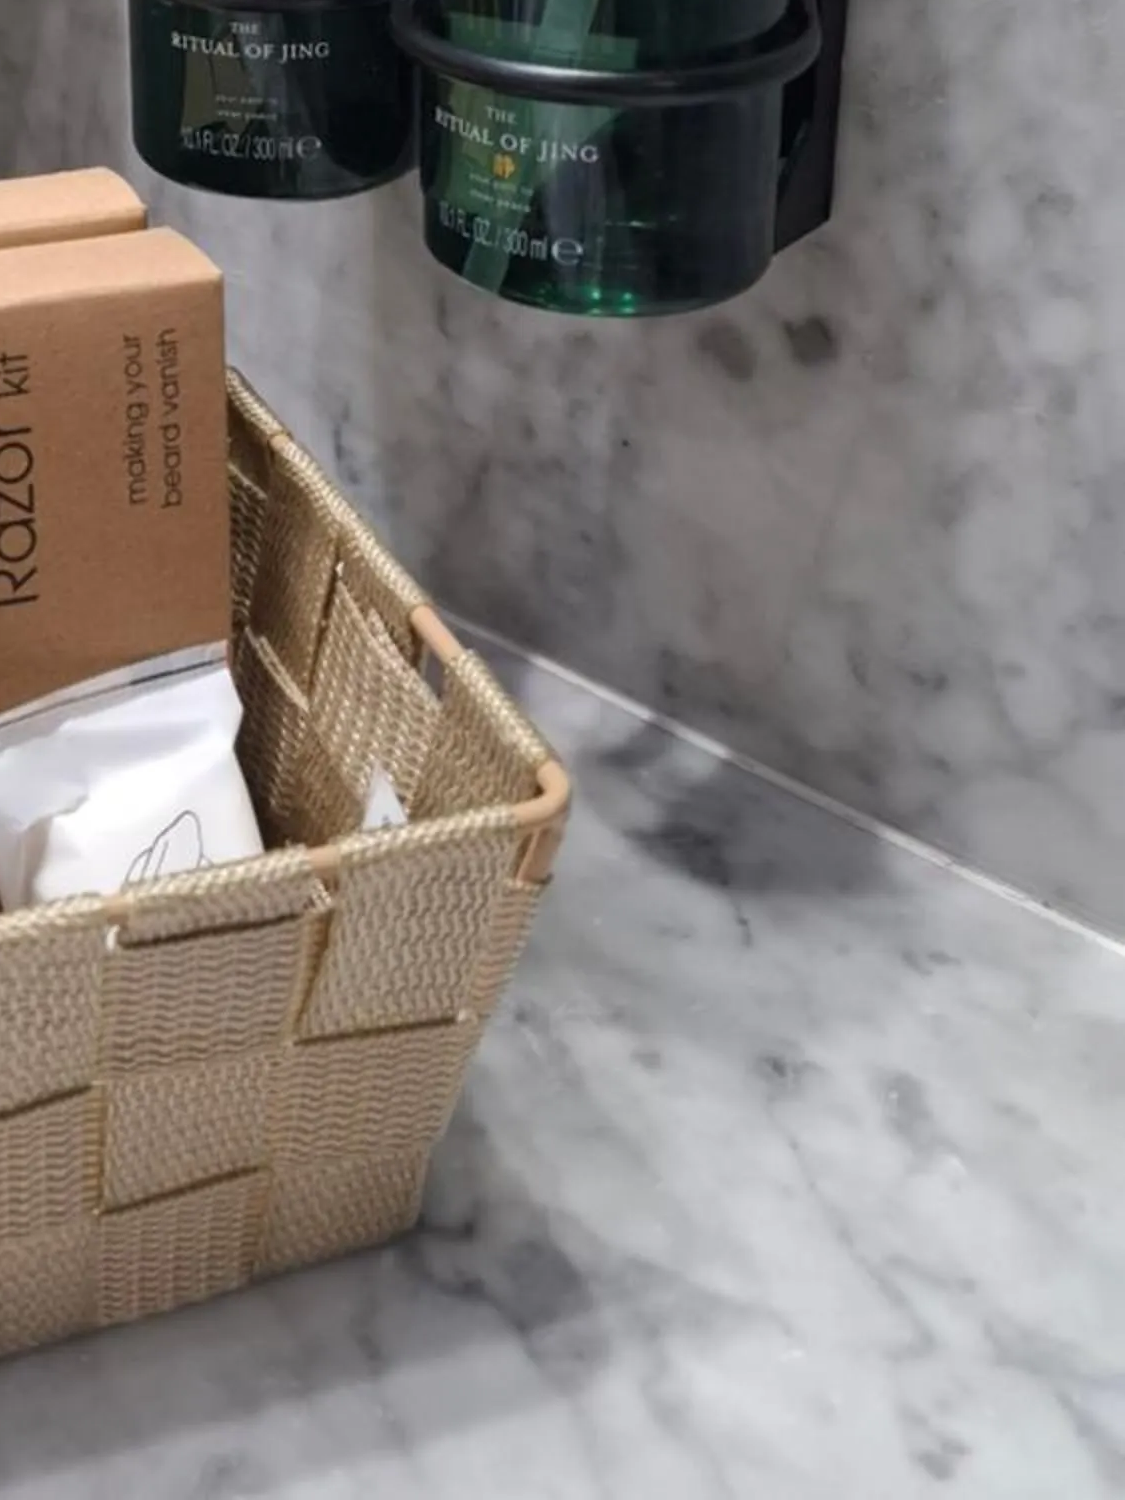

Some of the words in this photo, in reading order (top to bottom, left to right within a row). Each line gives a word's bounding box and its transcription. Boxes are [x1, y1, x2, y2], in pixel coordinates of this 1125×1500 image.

[170, 30, 240, 58] RITUAL
[243, 43, 275, 61] OF
[278, 41, 331, 64] JING
[229, 20, 262, 35] THE
[434, 107, 494, 148] RITUAL
[498, 133, 532, 156] OF
[536, 140, 600, 165] JING
[484, 104, 518, 125] THE
[123, 333, 147, 394] your
[156, 327, 180, 417] vanish
[123, 399, 149, 507] making
[158, 419, 182, 509] beard
